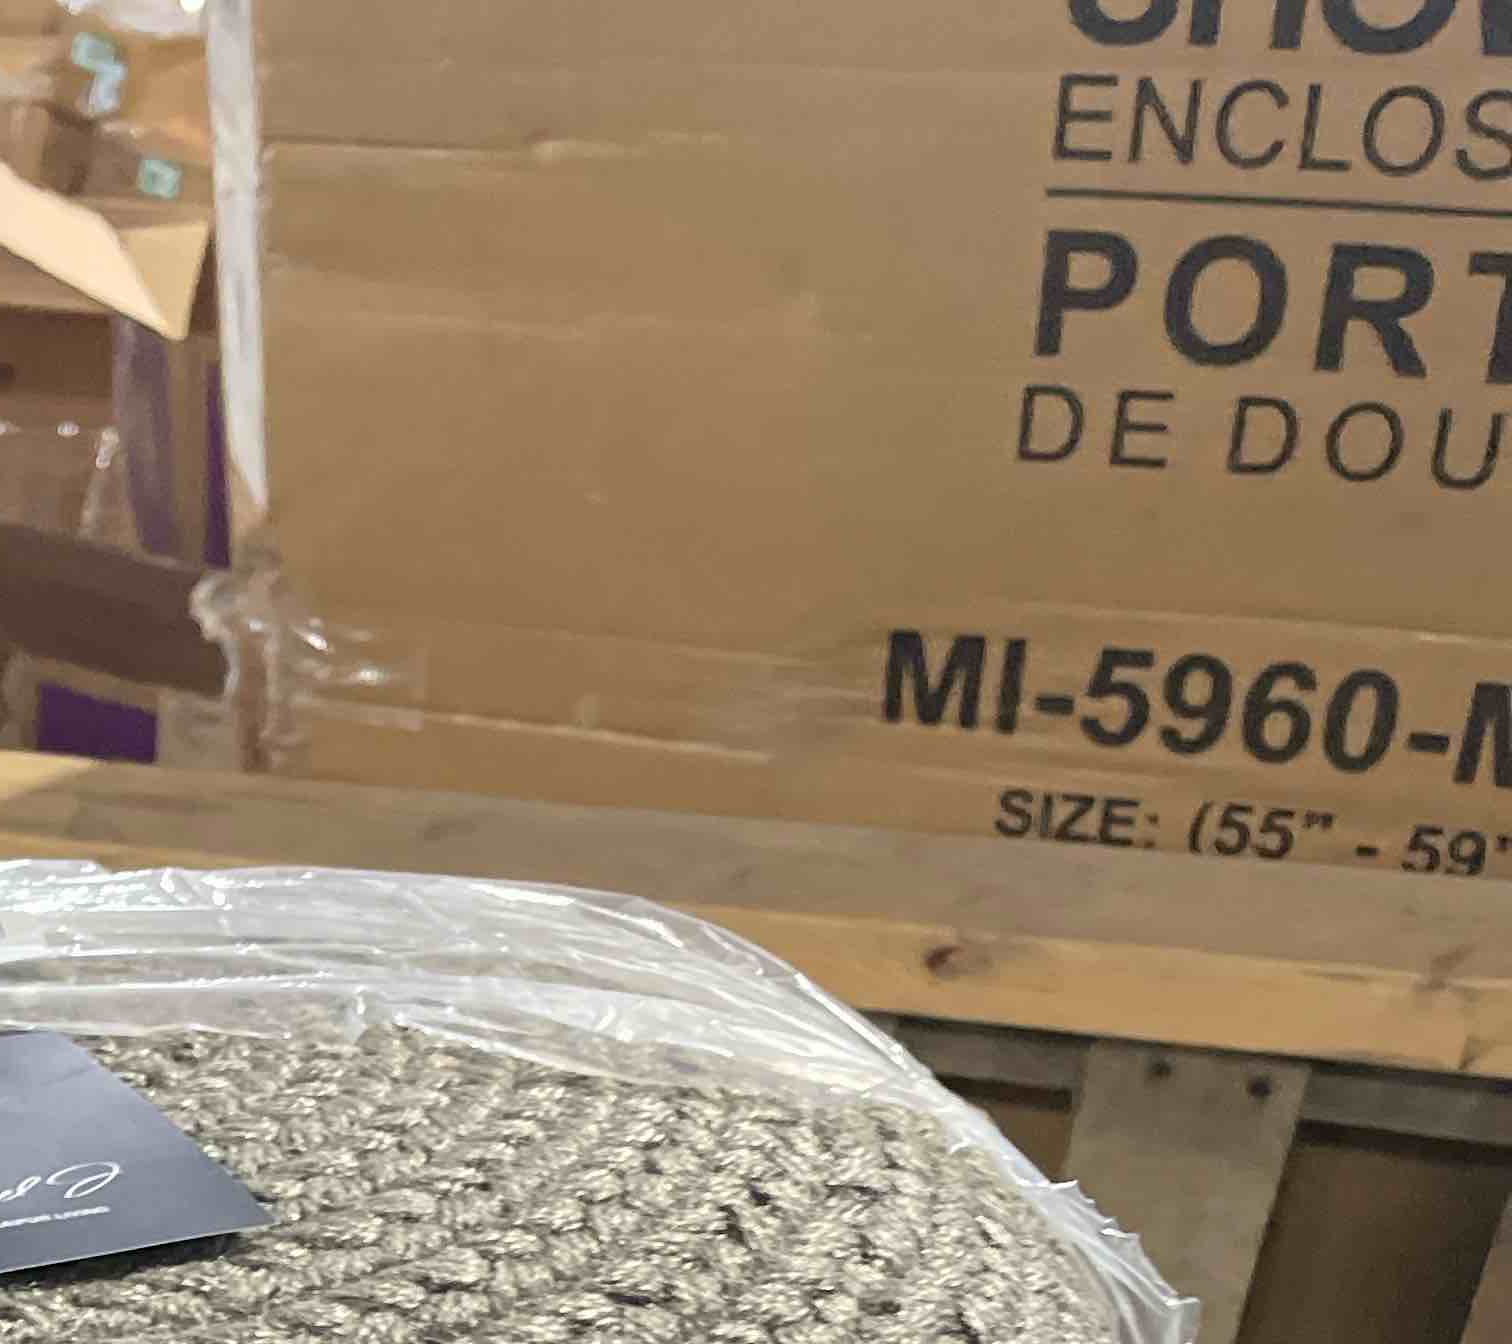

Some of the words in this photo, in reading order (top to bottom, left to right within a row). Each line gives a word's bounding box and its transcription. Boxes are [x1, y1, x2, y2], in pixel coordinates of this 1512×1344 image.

[1052, 73, 1512, 181] ENCLOS
[1017, 384, 1175, 469] DE
[1226, 396, 1509, 490] DOU
[993, 787, 1159, 849] SIZE:
